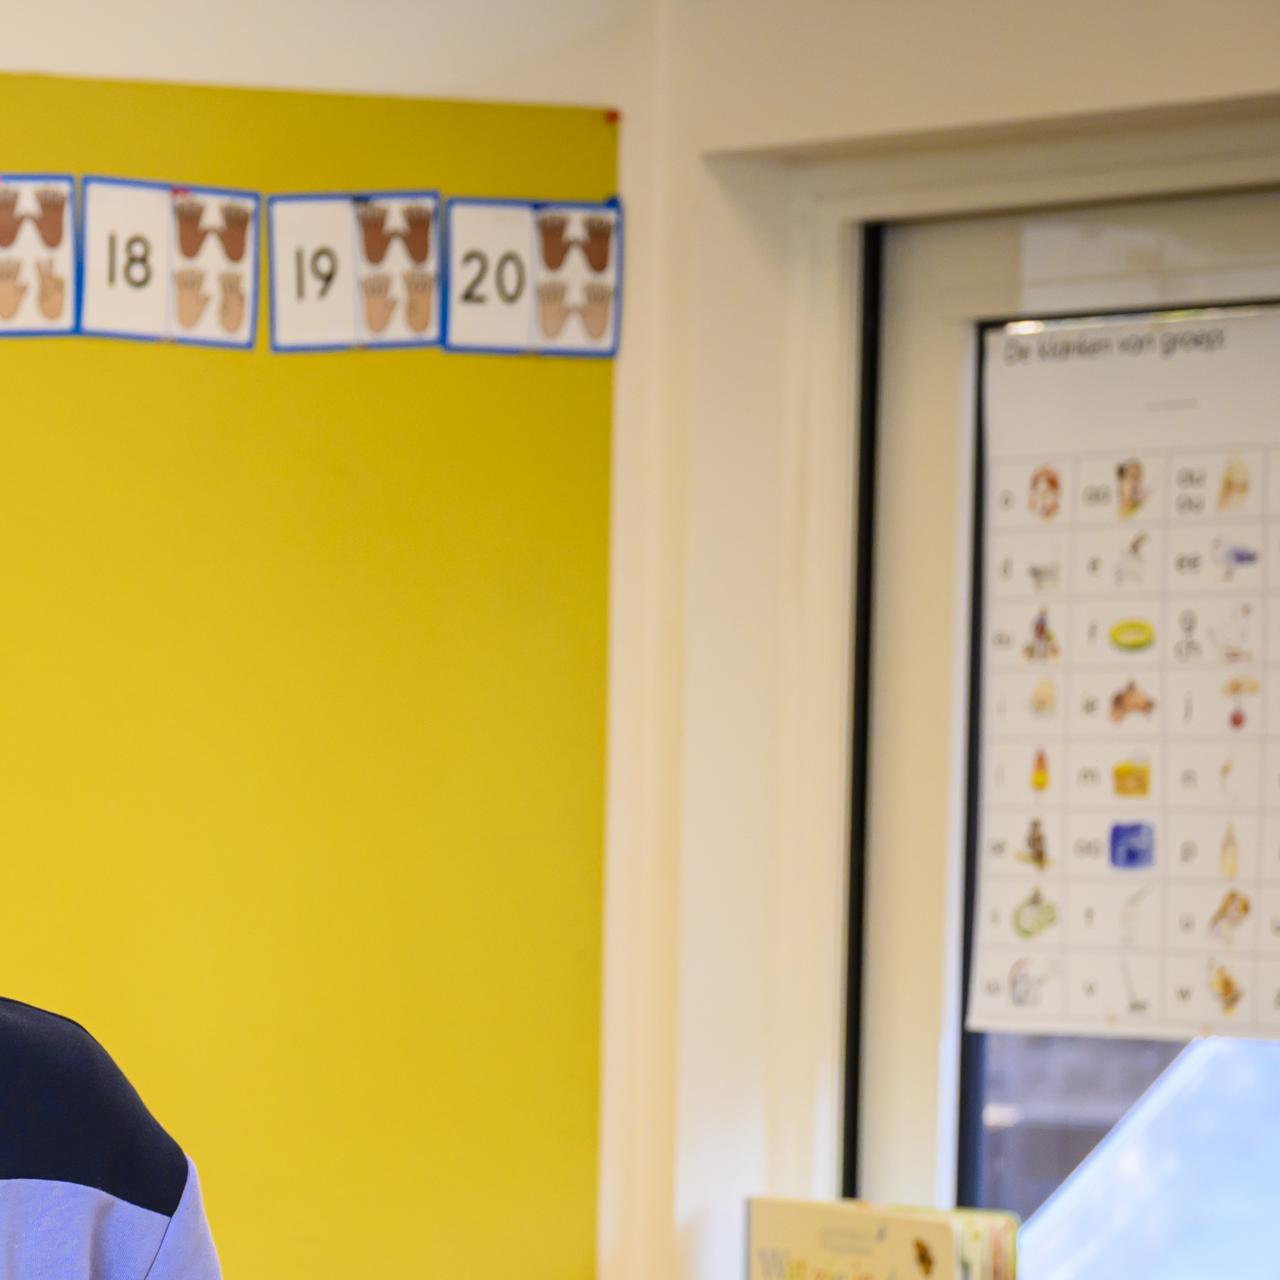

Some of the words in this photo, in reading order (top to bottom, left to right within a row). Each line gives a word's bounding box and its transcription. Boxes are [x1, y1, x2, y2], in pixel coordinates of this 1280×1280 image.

[107, 233, 153, 289] 18
[295, 246, 340, 301] 19
[460, 249, 527, 305] 20
